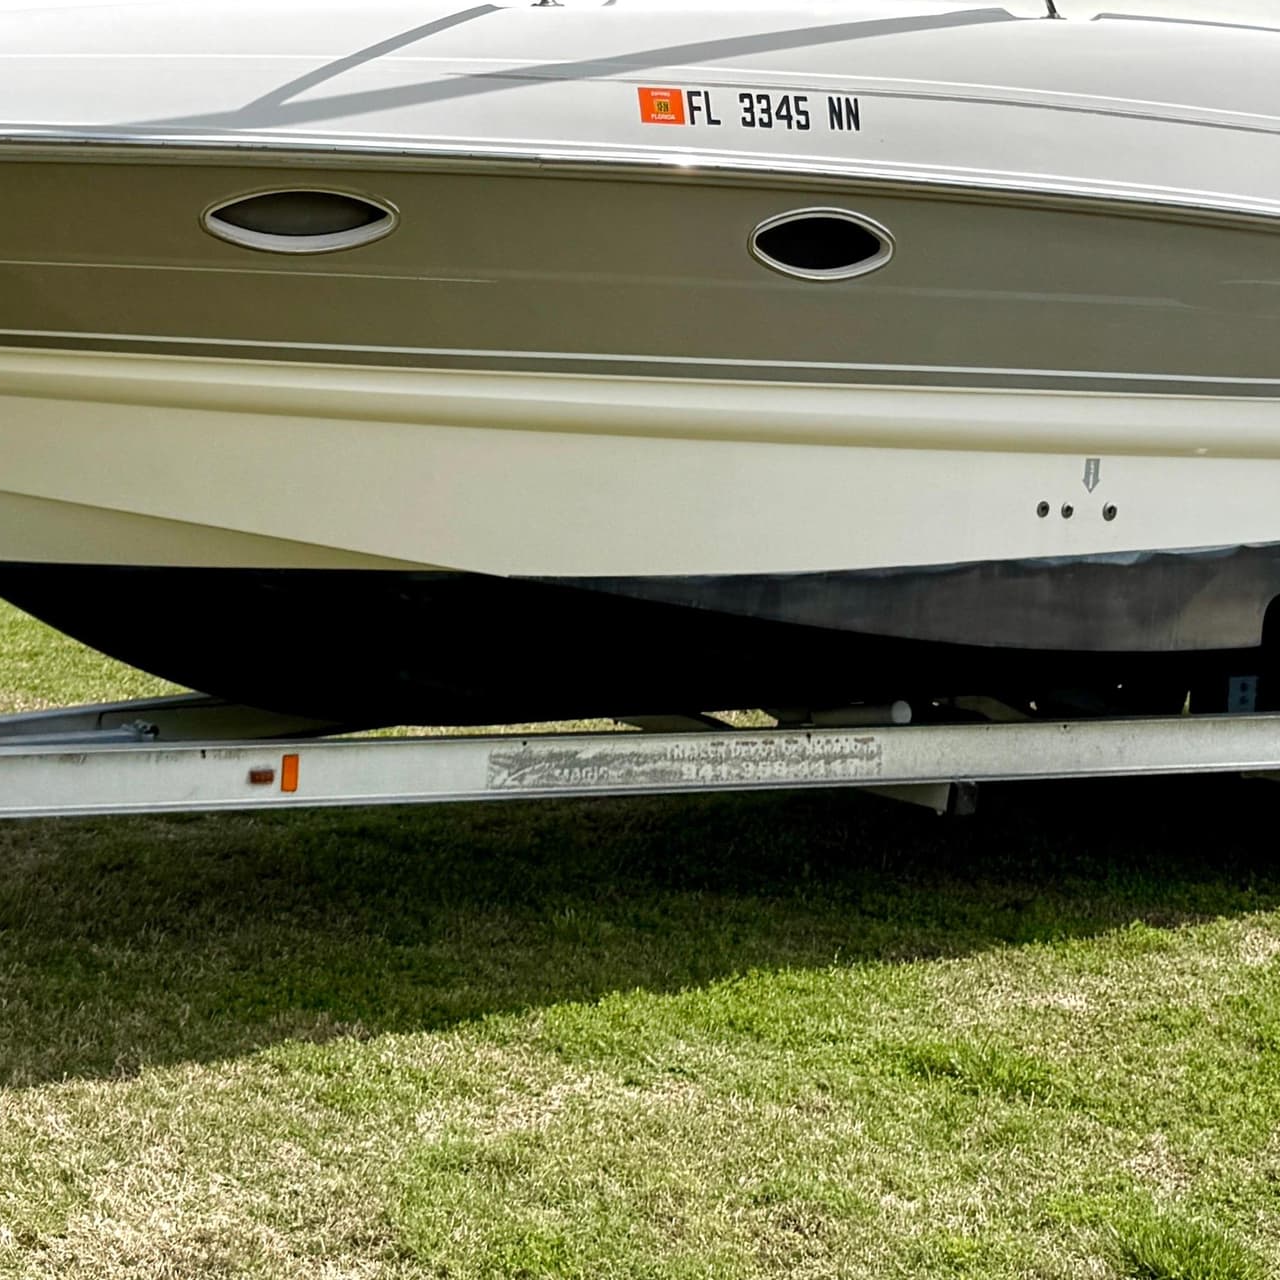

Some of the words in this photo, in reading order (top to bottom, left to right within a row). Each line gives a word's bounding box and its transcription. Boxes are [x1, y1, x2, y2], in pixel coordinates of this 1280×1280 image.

[686, 90, 721, 125] FL
[738, 92, 810, 130] 3345
[828, 95, 861, 131] NN
